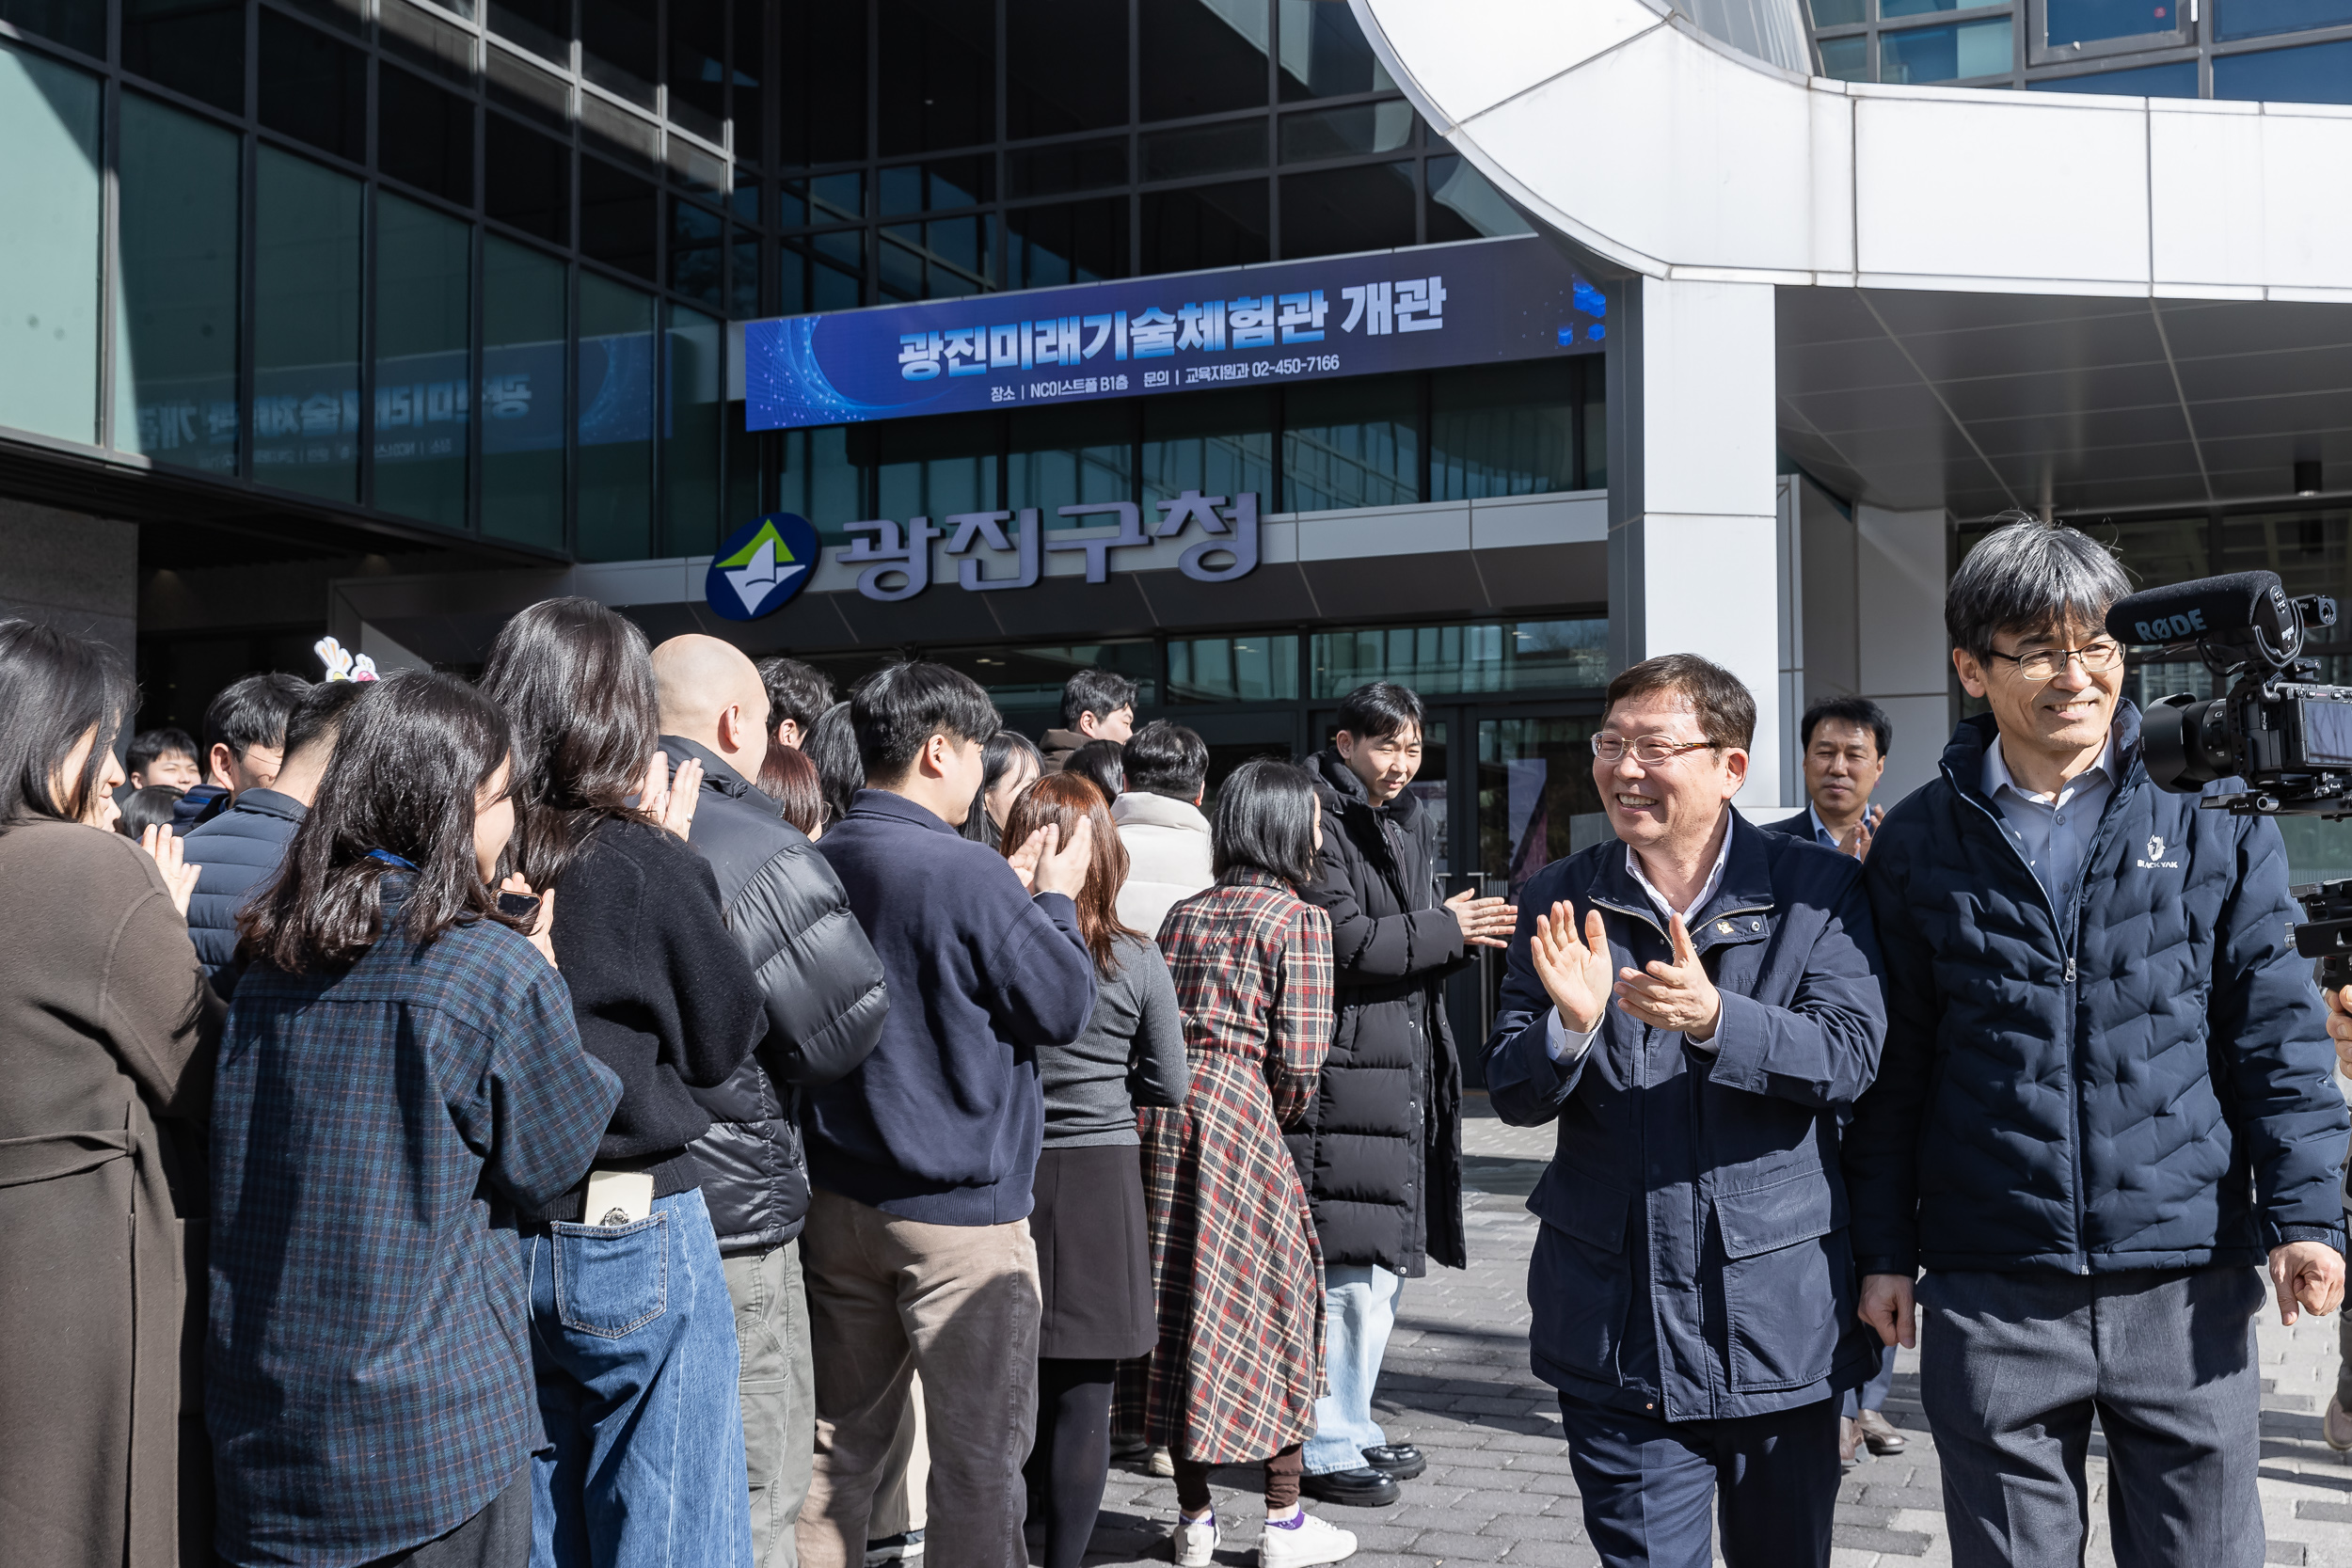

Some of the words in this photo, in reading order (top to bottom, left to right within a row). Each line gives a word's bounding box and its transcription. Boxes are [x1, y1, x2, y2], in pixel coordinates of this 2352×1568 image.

[898, 289, 1329, 381] 광진미래기술체험관
[1341, 275, 1447, 337] 개관
[991, 386, 1016, 403] 장소
[1100, 373, 1129, 392] B1층
[1143, 371, 1169, 388] 문의
[1184, 363, 1250, 385] 교육지원과
[1252, 355, 1341, 378] 02-450-7166
[835, 490, 1263, 602] 광진구청
